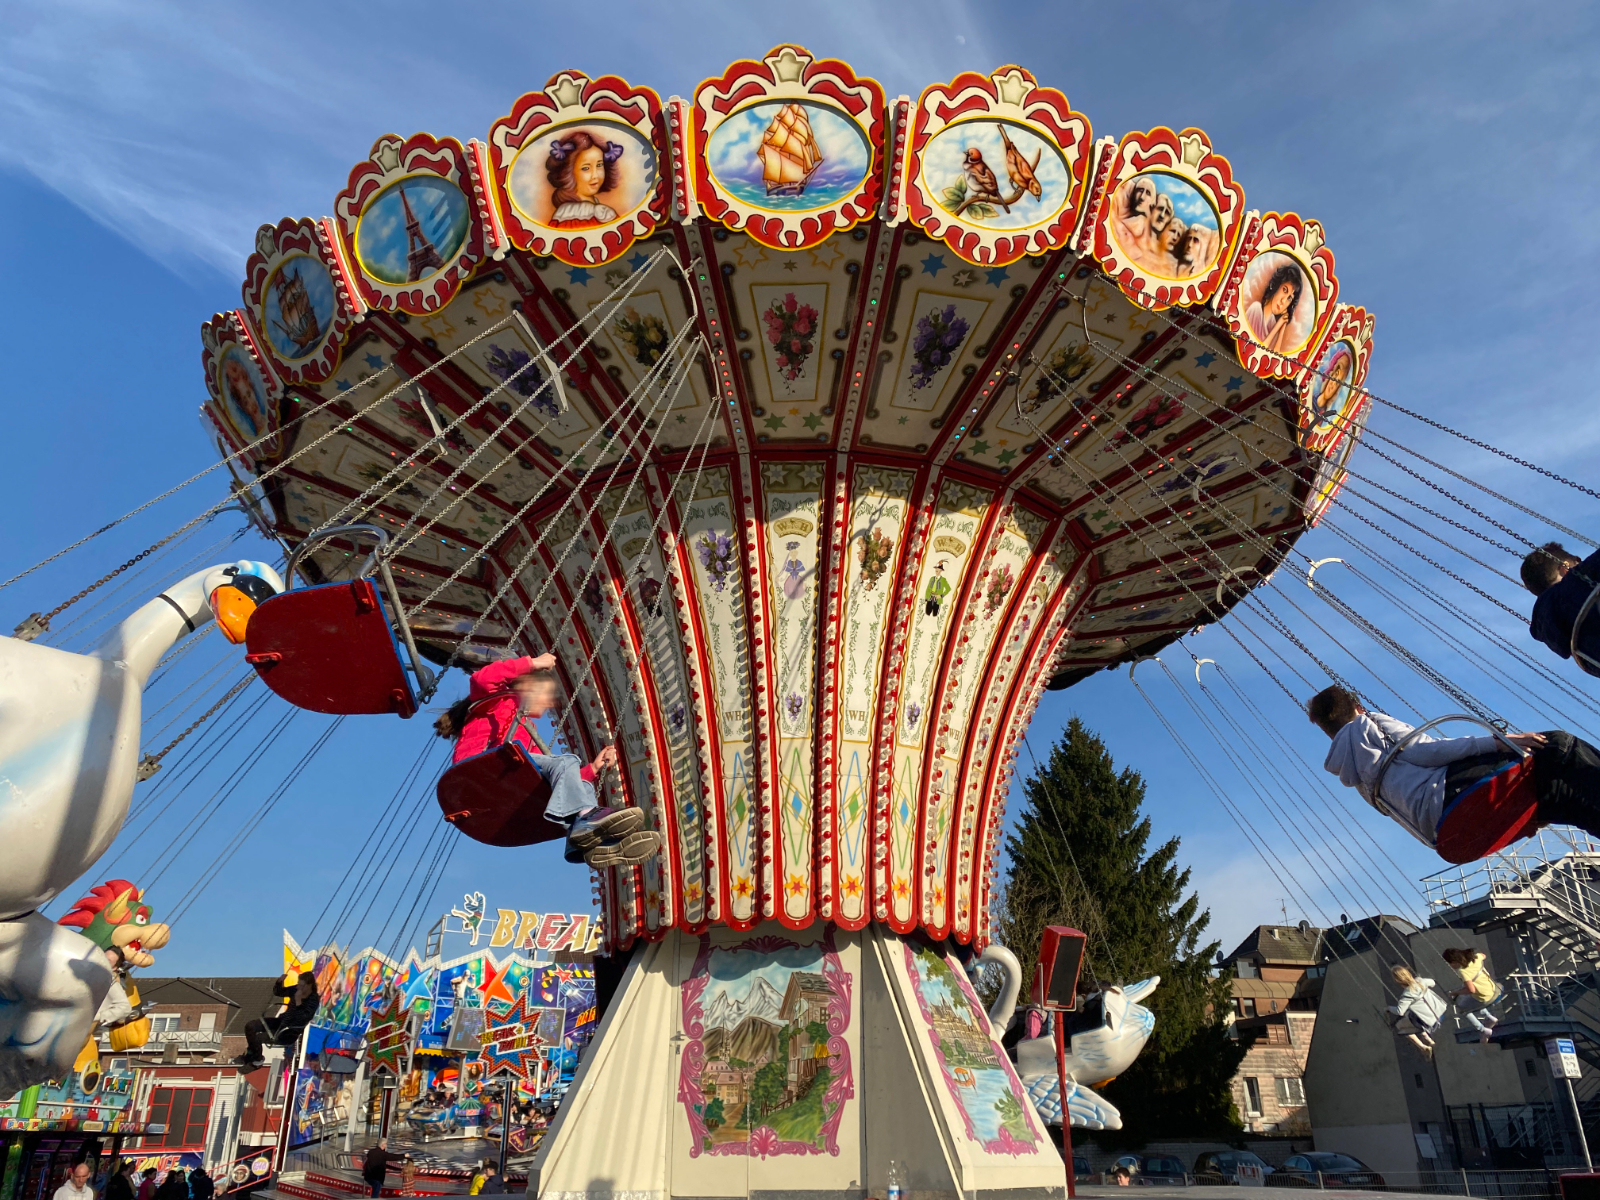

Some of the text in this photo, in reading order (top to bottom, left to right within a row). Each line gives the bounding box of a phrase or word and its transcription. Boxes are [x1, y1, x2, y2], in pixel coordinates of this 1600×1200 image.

[725, 710, 742, 722] WH
[849, 710, 866, 722] WH
[134, 1155, 182, 1172] DANCE
